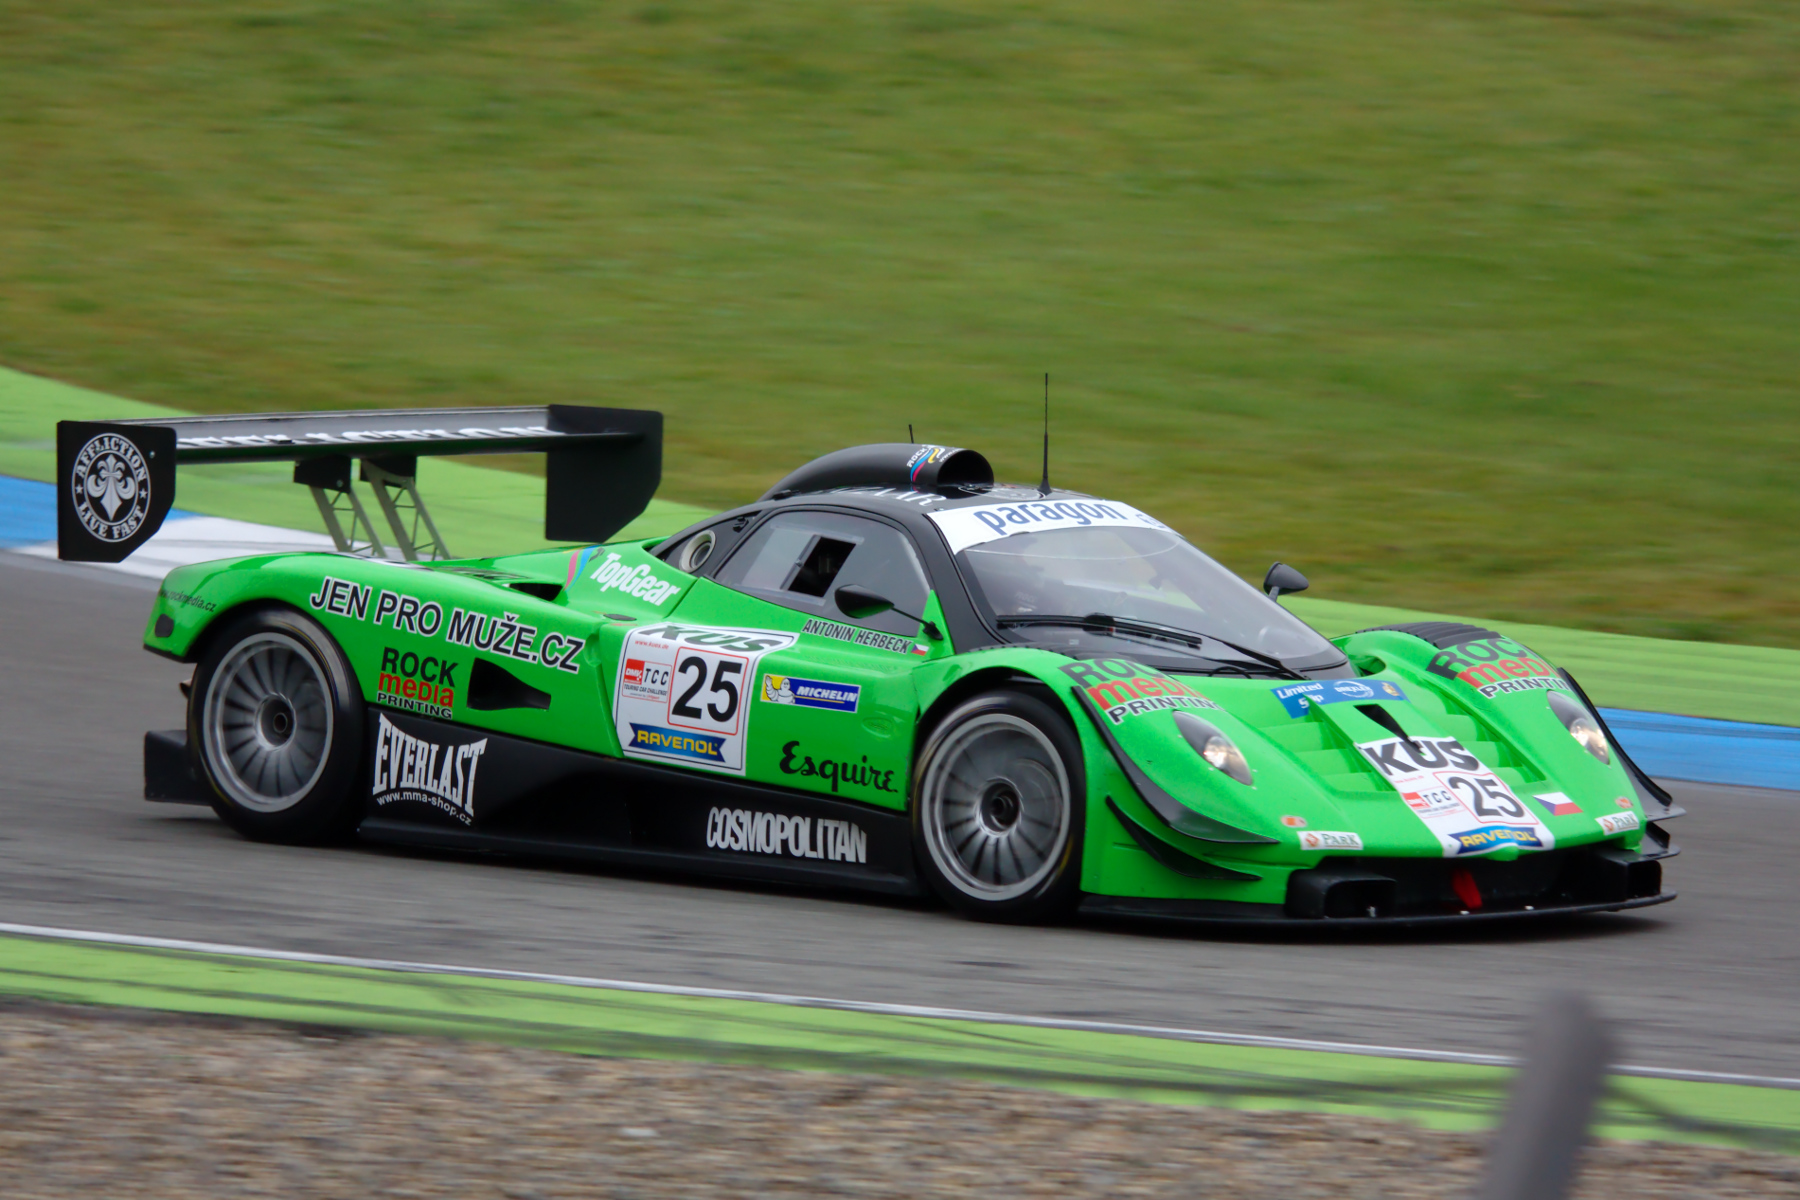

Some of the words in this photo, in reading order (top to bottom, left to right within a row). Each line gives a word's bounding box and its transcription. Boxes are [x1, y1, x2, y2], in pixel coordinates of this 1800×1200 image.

[76, 437, 148, 482] AFFLICTION
[78, 502, 109, 537] LIVE
[111, 505, 144, 539] FAST
[973, 502, 1129, 536] paragon
[590, 552, 681, 606] TopGear
[310, 576, 372, 620] JEN
[373, 590, 443, 637] PRO
[446, 612, 586, 674] MUŽE.CZ
[802, 618, 854, 643] ANTONIN
[853, 629, 913, 655] HERBECK
[381, 646, 459, 688] ROCK
[377, 691, 453, 719] PRINTING
[671, 656, 743, 722] 25
[797, 686, 858, 703] MICHELIN
[1276, 683, 1325, 700] Limited
[637, 729, 718, 756] RAVENOL
[372, 712, 488, 817] EVERLAST
[779, 740, 899, 793] Esquire
[377, 791, 473, 826] www.mma-shop.cz
[1448, 776, 1525, 818] 25
[706, 806, 867, 864] COSMOPOLITAN
[1459, 830, 1538, 848] RAVENOL
